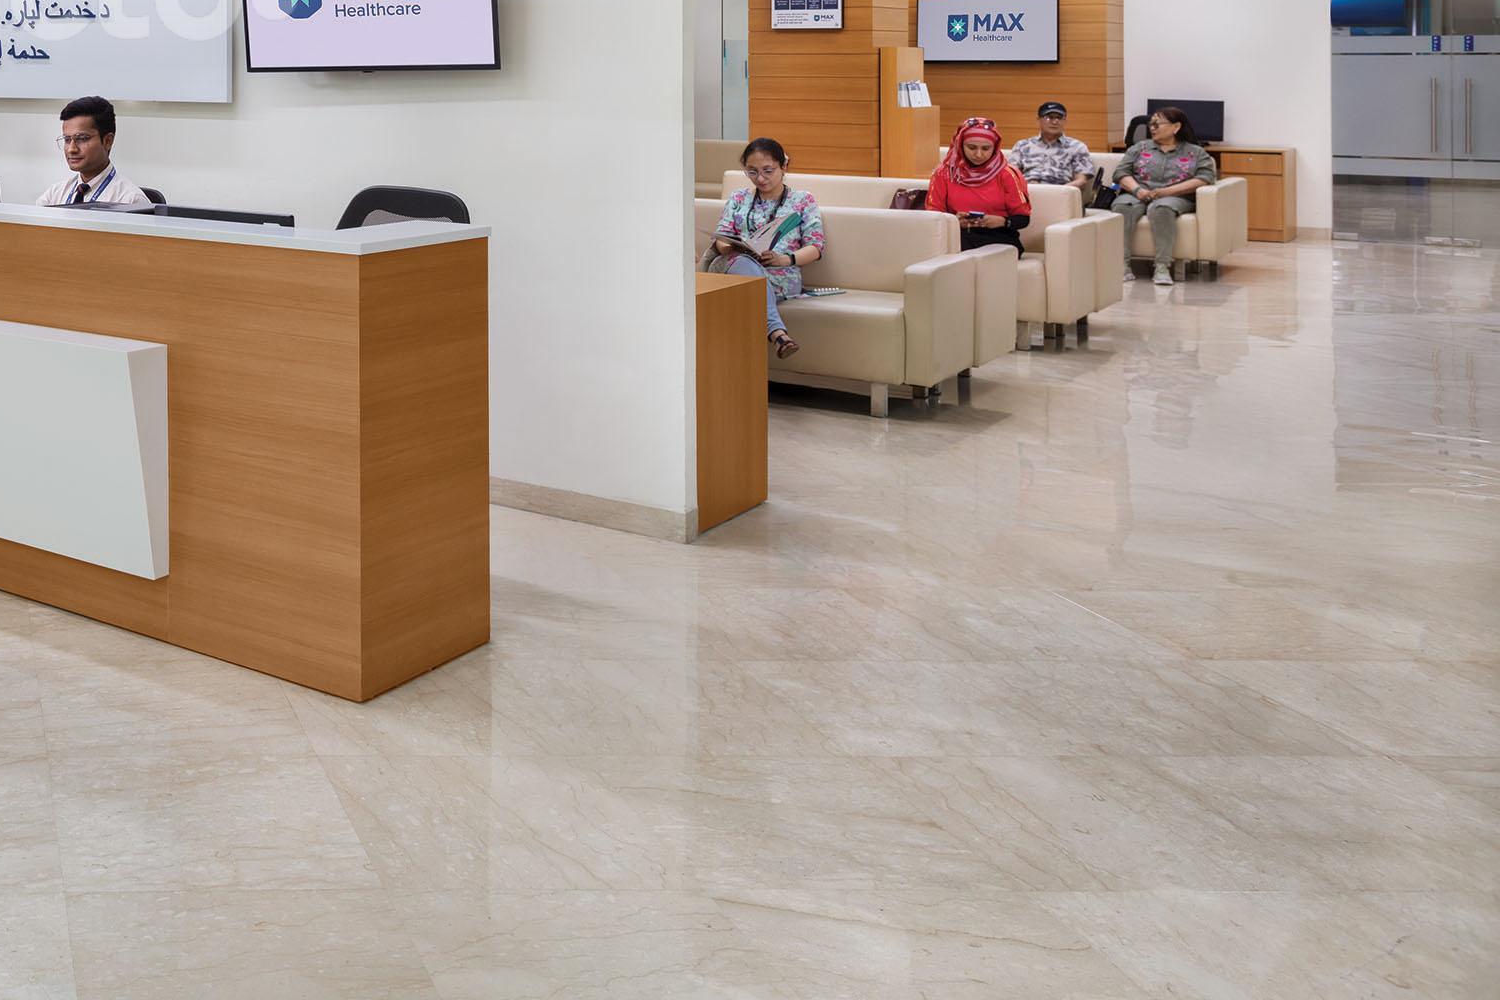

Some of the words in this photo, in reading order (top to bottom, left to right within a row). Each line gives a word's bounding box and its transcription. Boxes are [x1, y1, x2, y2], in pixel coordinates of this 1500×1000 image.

[335, 1, 421, 17] Healthcare
[973, 13, 1024, 32] MAX
[973, 34, 1013, 42] Healthcare
